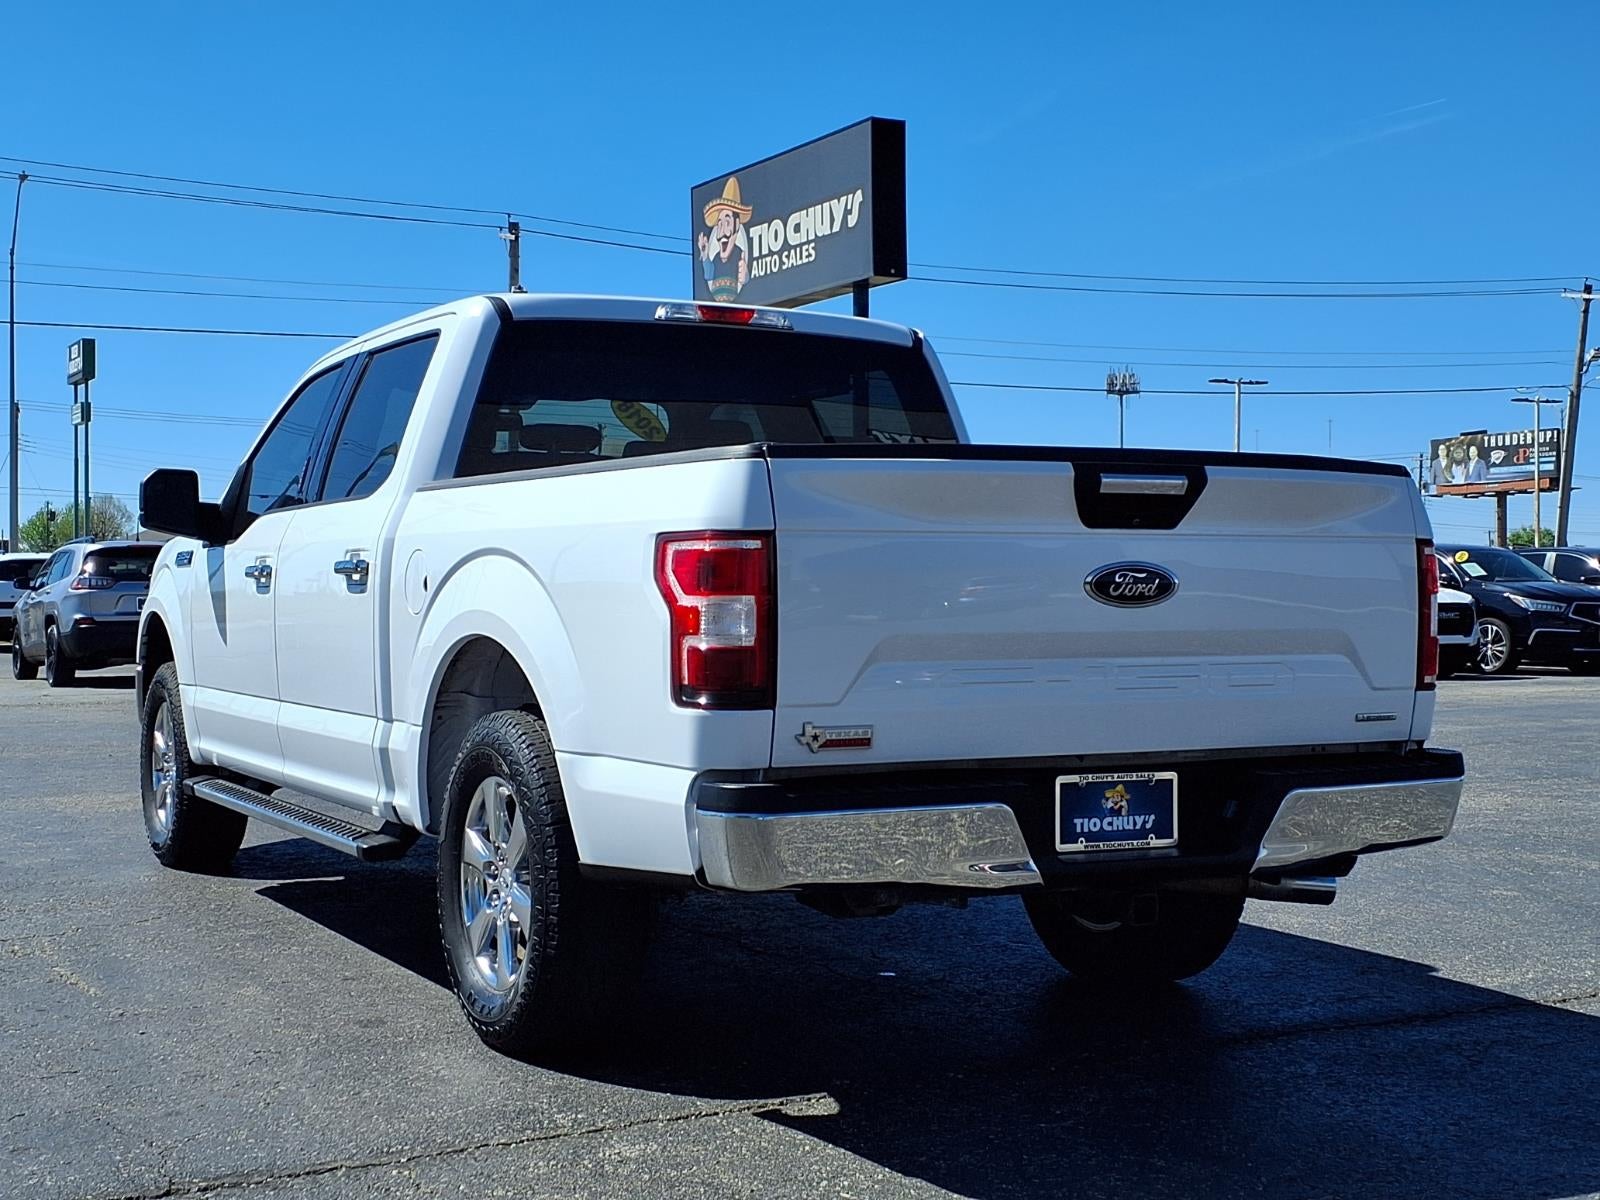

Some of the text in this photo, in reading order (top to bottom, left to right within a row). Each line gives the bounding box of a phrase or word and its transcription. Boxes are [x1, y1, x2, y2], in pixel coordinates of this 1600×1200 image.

[749, 188, 864, 258] TIO CHUY'S
[751, 242, 816, 279] AUTO SALES
[1483, 430, 1558, 448] THUNDER UP!
[1109, 571, 1160, 597] Ford
[1078, 775, 1090, 783] TIO
[1073, 813, 1156, 833] TIO CHUY'S
